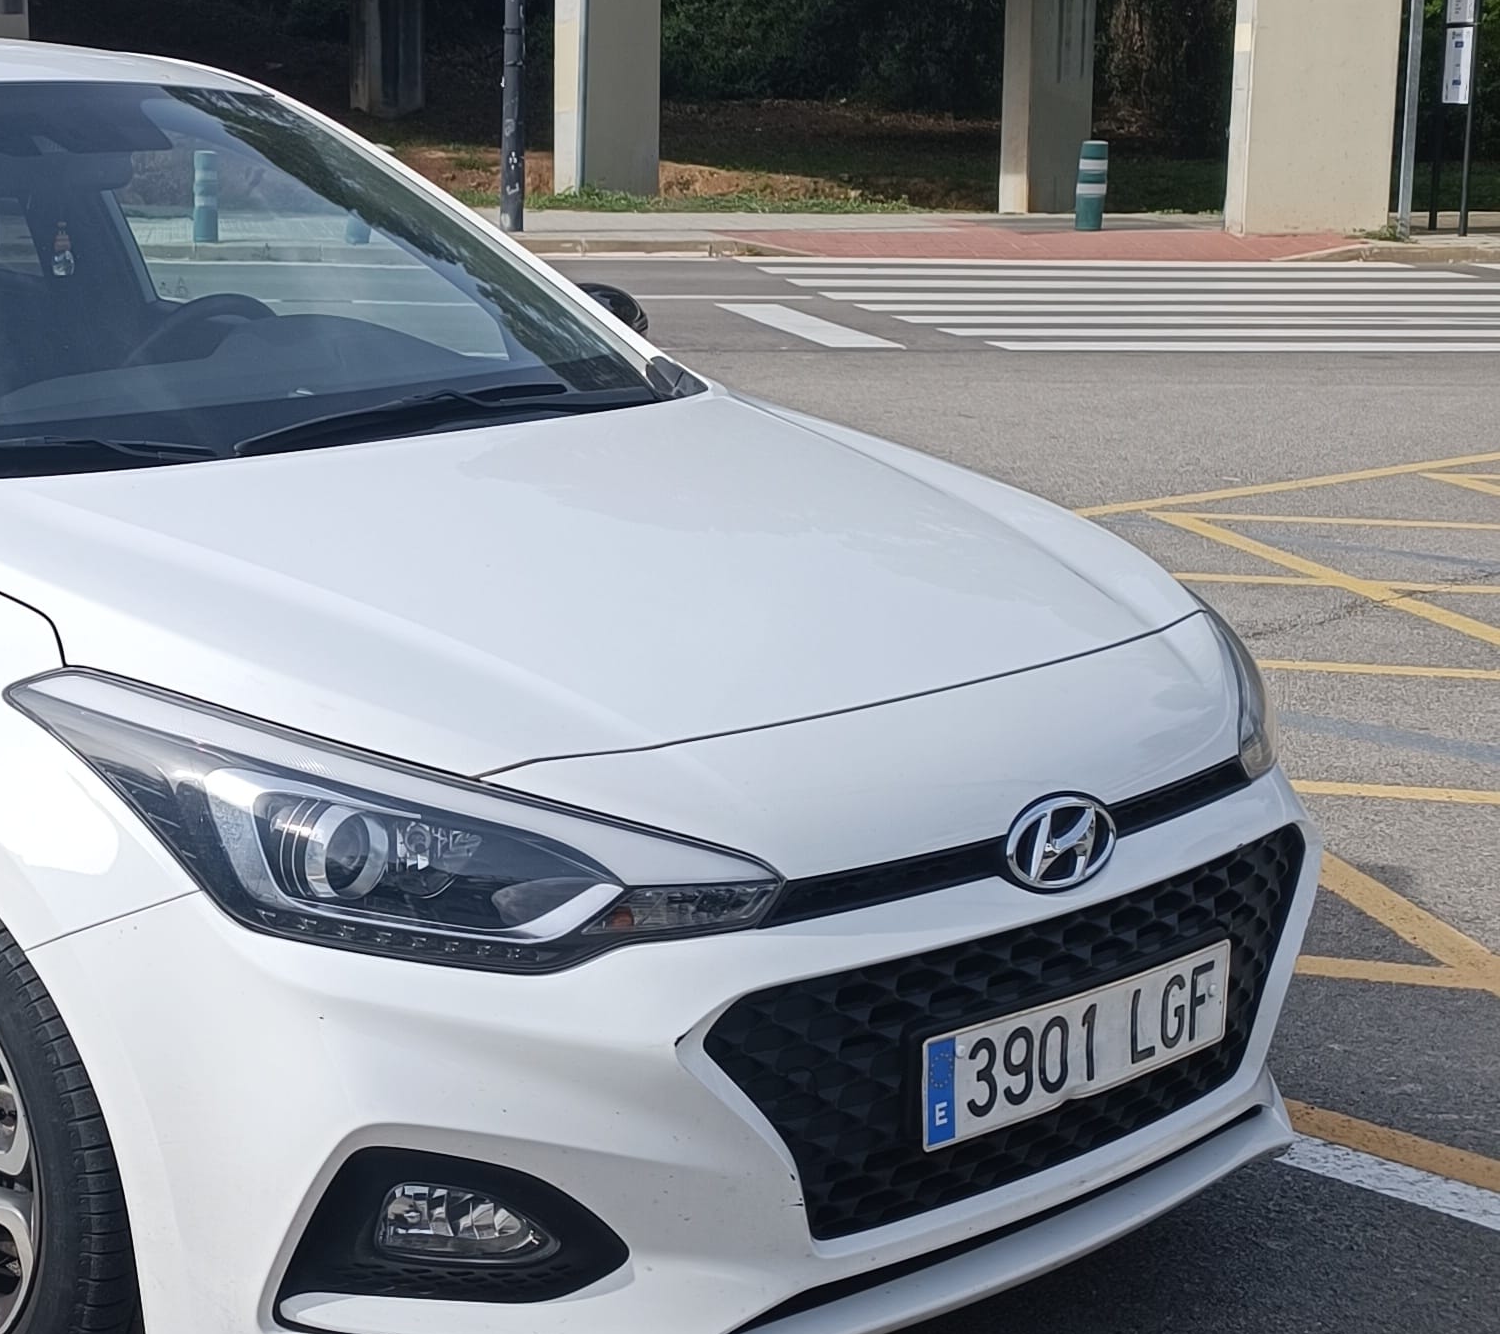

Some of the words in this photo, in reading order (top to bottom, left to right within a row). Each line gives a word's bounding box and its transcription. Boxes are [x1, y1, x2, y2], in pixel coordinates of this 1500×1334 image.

[966, 1002, 1098, 1118] 3901
[1130, 959, 1215, 1065] LGF
[934, 1101, 948, 1126] E
